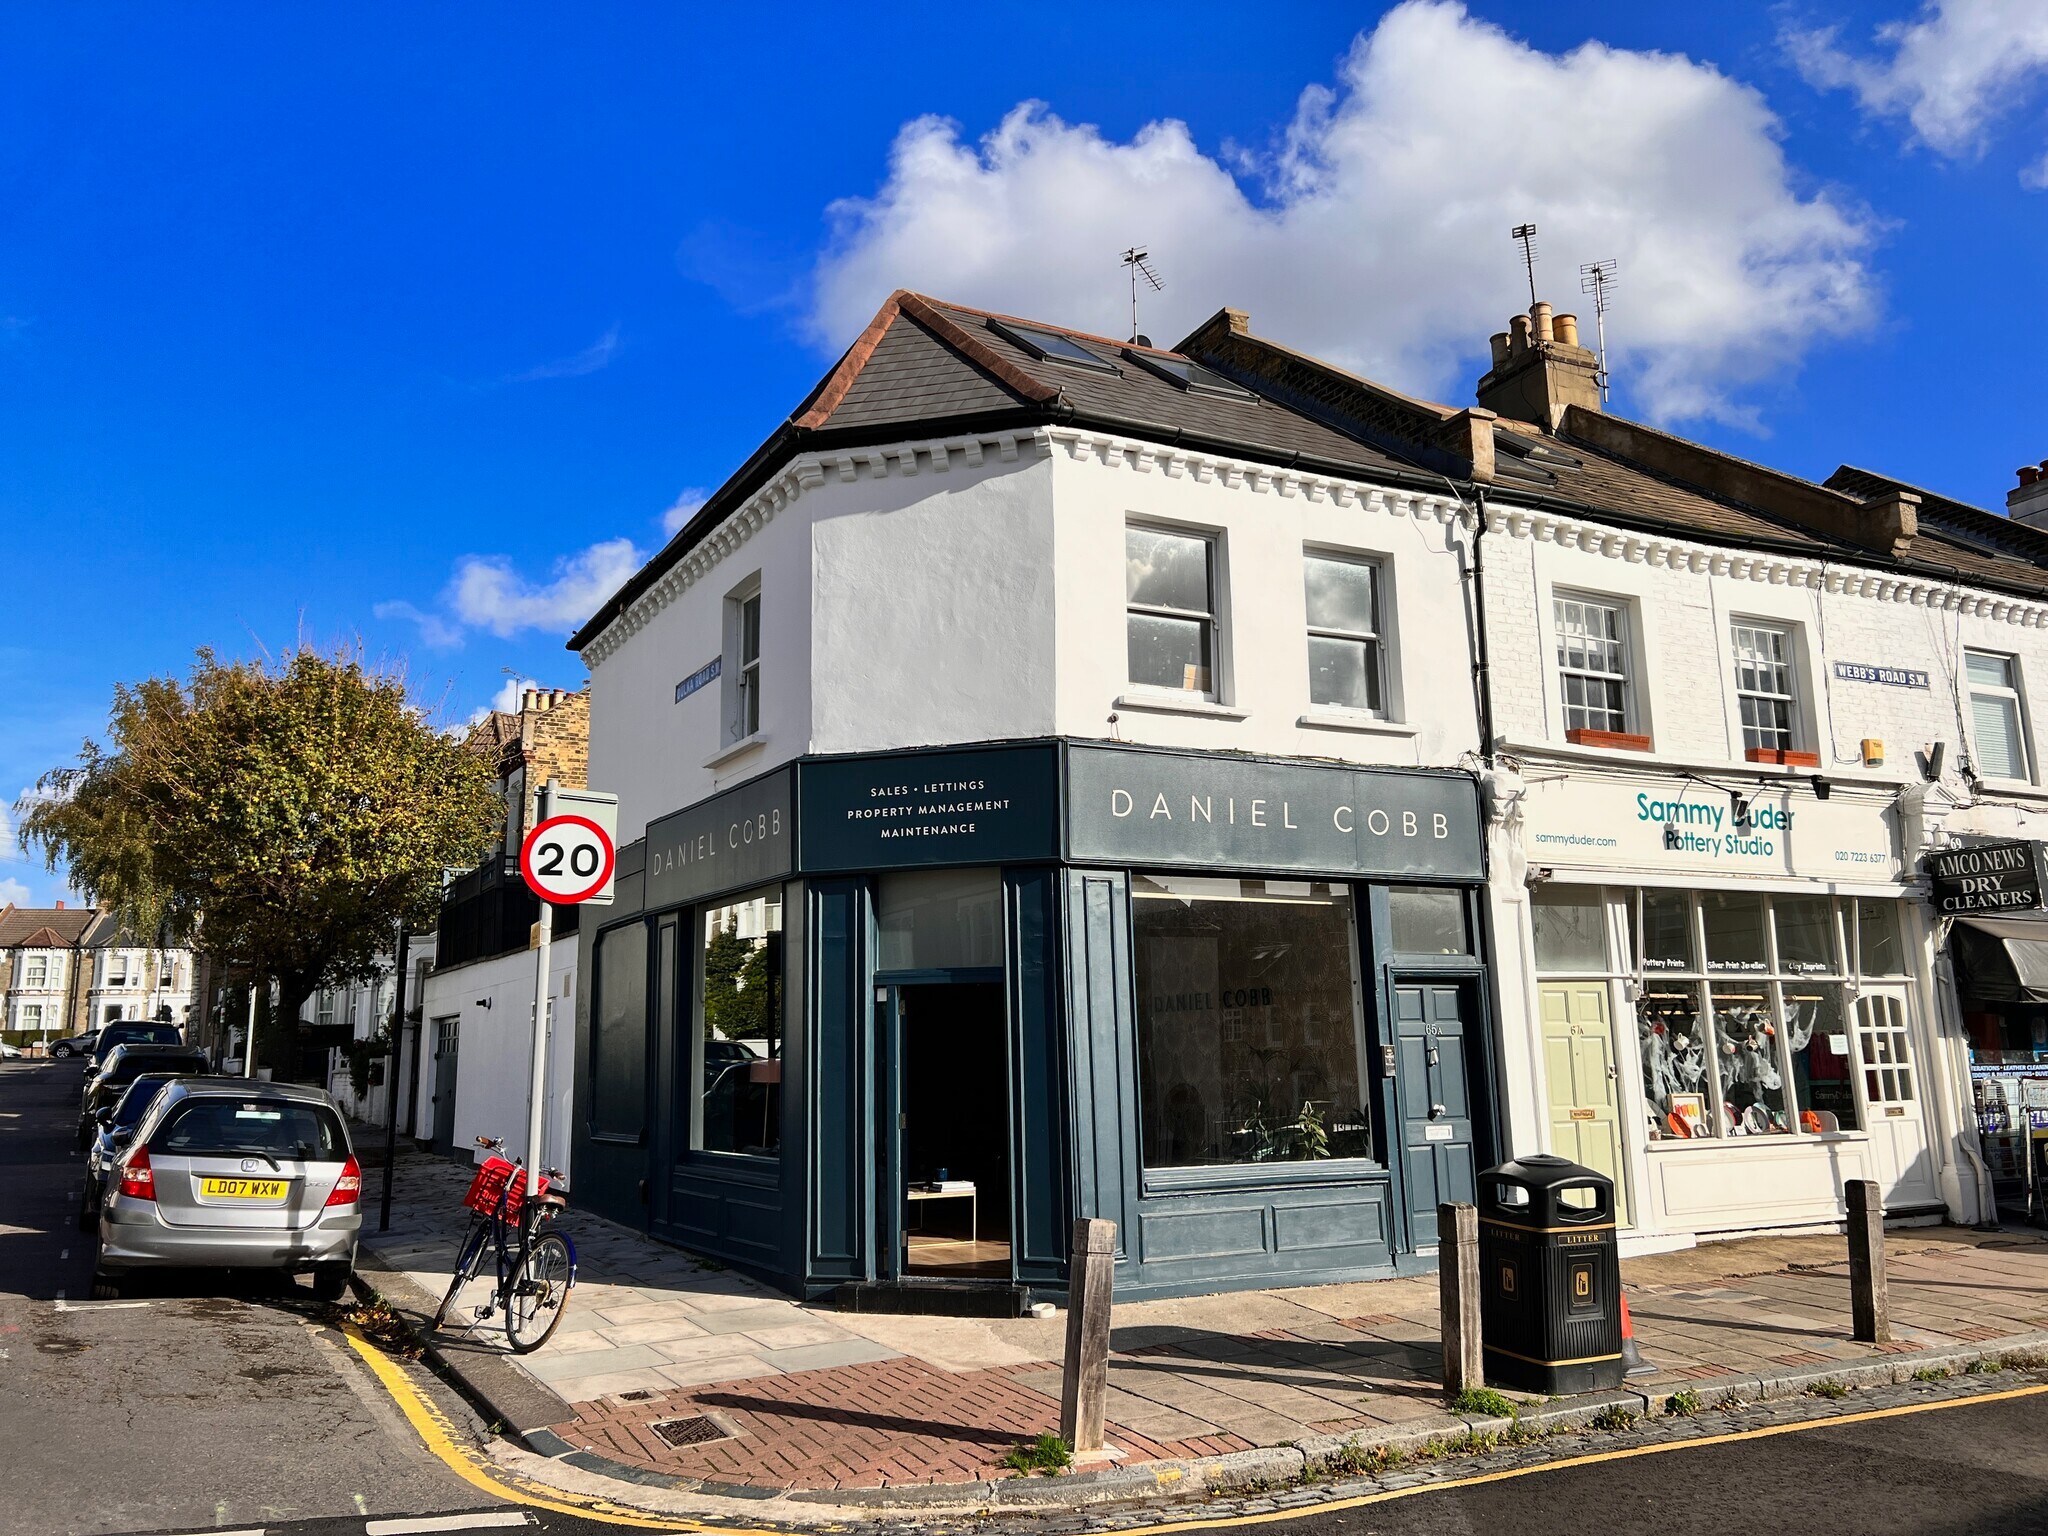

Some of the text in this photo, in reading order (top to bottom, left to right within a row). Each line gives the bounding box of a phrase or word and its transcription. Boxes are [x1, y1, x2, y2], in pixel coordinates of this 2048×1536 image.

[1837, 664, 1928, 687] WEBB'S ROAD S.W.
[870, 780, 985, 798] SALES LETTINGS
[847, 799, 1010, 820] PROPERTY MANAGEMENT
[1111, 788, 1450, 840] DANIEL COBB
[1636, 792, 1725, 833] Sammy
[880, 823, 976, 839] MAINTENANCE
[653, 808, 781, 876] DANIEL COBB
[1535, 833, 1617, 848] sammyduder.com
[1665, 830, 1774, 858] Pottery Studio
[1950, 837, 1962, 850] 69
[537, 842, 599, 878] 20
[1834, 850, 1886, 863] 020 7223 6377
[1938, 852, 1980, 877] AMCO
[1982, 847, 2026, 872] NEWS
[1961, 875, 2005, 894] DRY
[1942, 889, 2033, 911] CLEANERS
[1643, 957, 1685, 969] Pottery Prints
[1707, 960, 1725, 970] Silver
[1725, 960, 1740, 970] Print
[1802, 962, 1827, 972] Imprints
[1153, 987, 1273, 1013] DANIEL COBB
[1570, 1025, 1584, 1035] 67A
[207, 1180, 280, 1196] LD07 WXW
[1491, 1228, 1520, 1241] LITTER
[1567, 1234, 1600, 1244] LITTER
